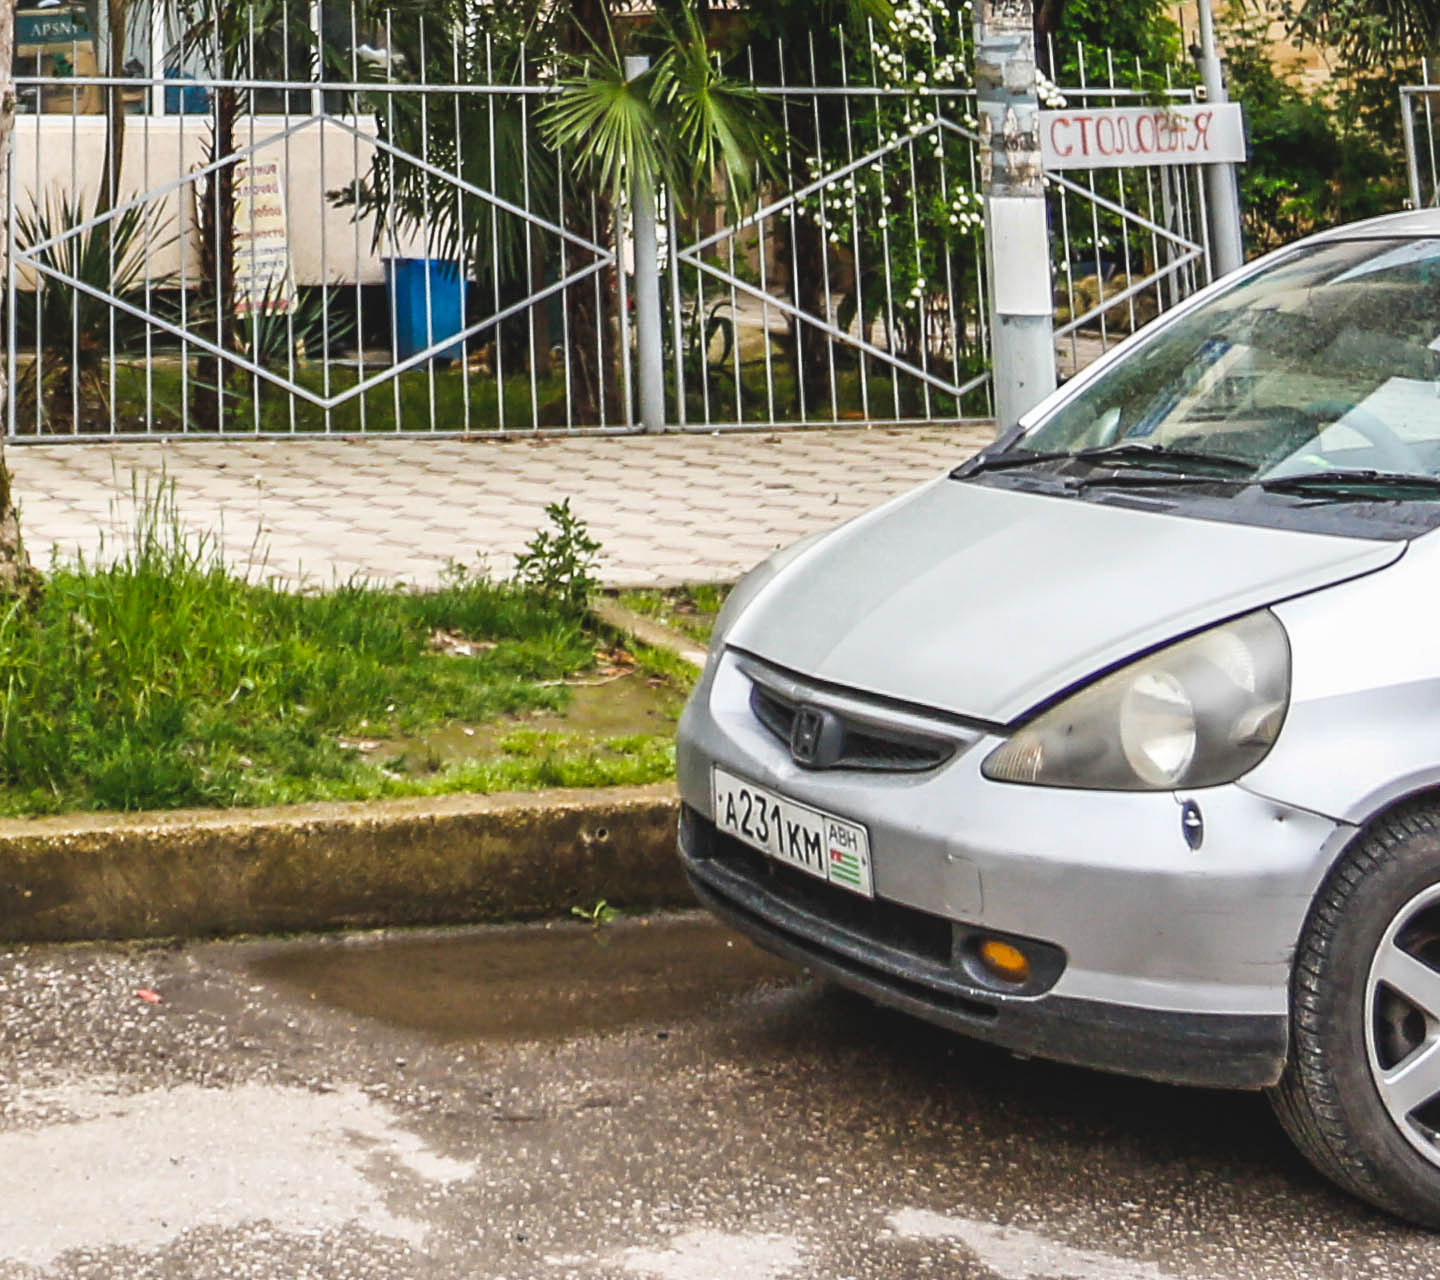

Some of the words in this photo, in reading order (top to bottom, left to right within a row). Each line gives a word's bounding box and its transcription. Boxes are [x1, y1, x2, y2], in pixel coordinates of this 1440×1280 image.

[1050, 111, 1213, 157] СТОЛОВАЯ
[726, 789, 823, 870] A231KM
[828, 823, 858, 850] ABH
